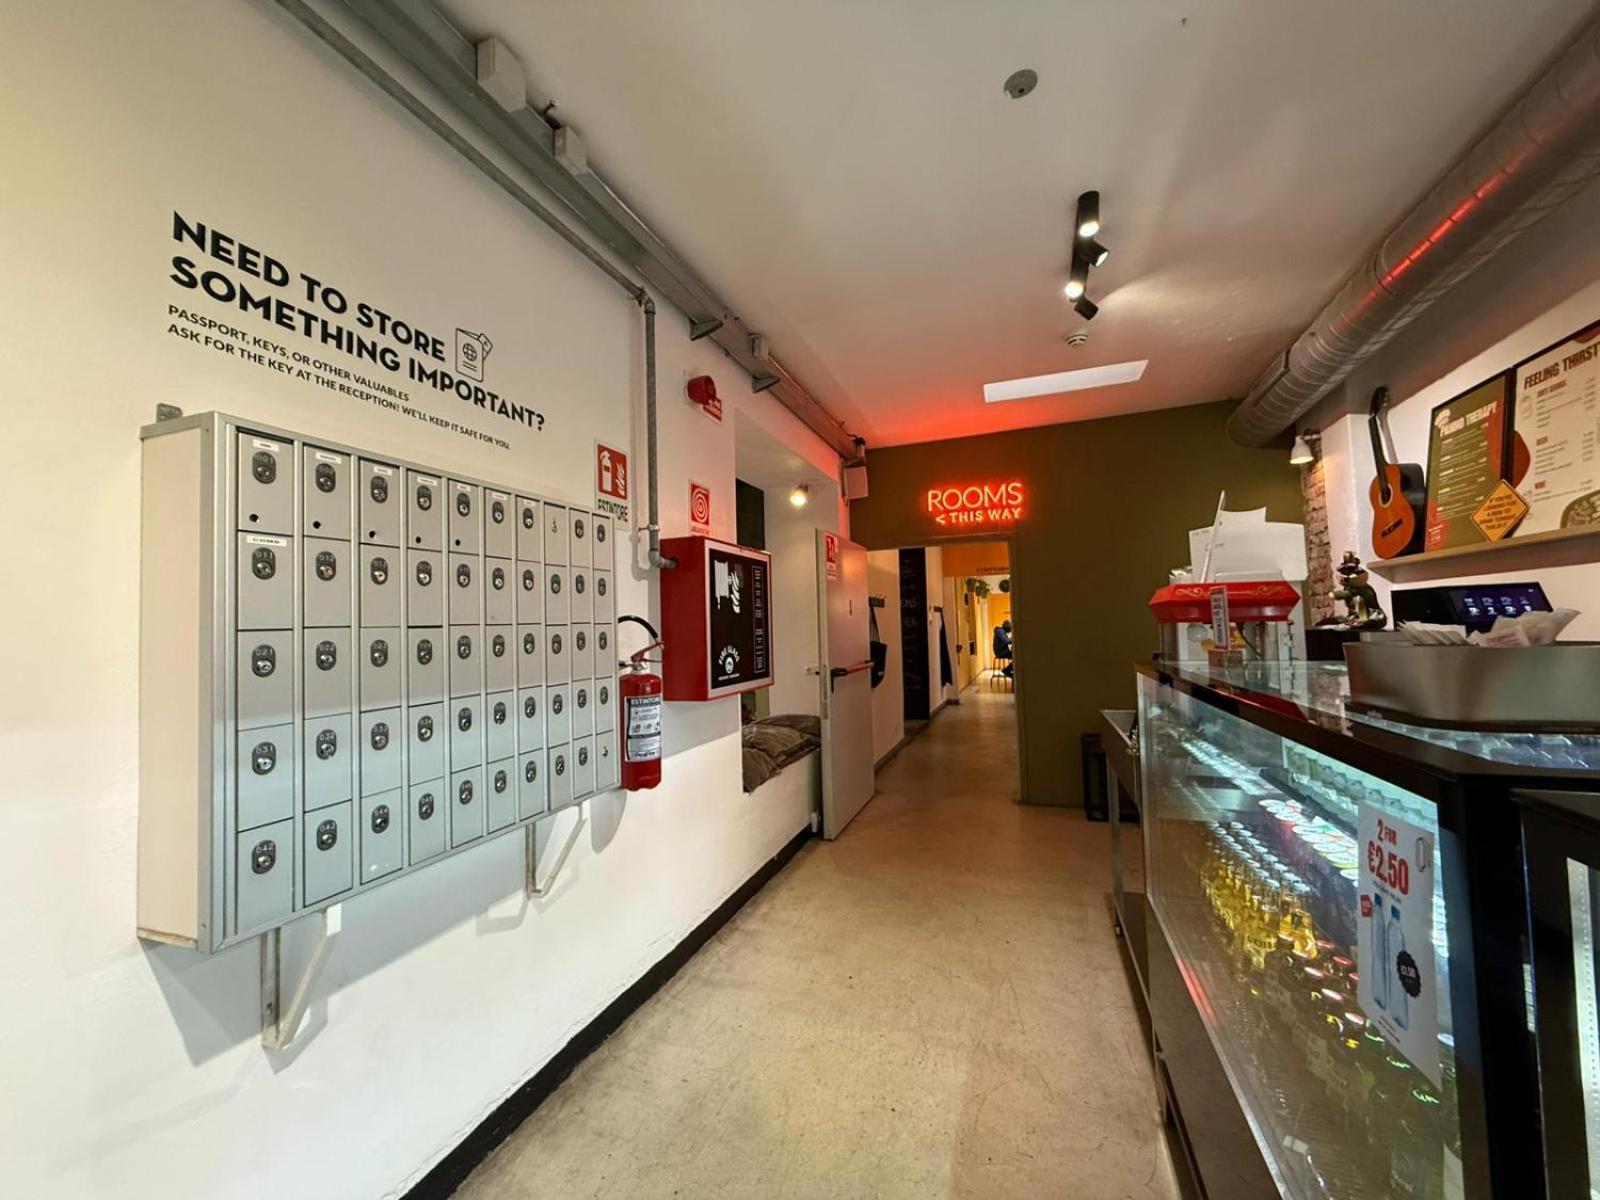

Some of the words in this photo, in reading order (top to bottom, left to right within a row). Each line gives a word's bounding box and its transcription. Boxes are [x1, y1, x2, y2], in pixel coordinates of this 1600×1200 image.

[173, 210, 290, 289] NEED
[300, 272, 347, 315] TO
[356, 302, 446, 362] STORE
[168, 304, 251, 345] PASSPORT,
[253, 336, 290, 360] KEYS,
[291, 351, 311, 366] OR
[312, 359, 352, 382] OTHER
[353, 373, 410, 402] VALUABLES
[169, 256, 401, 373] SOMETHING
[408, 357, 546, 432] IMPORTANT?
[1523, 362, 1560, 390] FEELING
[1561, 341, 1600, 372] THIRST
[167, 323, 201, 344] ASK
[204, 335, 235, 356] FOR
[238, 347, 265, 366] THE
[268, 358, 294, 376] KEY
[296, 369, 312, 382] AT
[314, 374, 337, 391] THE
[338, 383, 400, 413] RECEPTION!
[401, 404, 429, 422] WE'LL
[429, 415, 450, 429] KEEP
[450, 422, 460, 433] IT
[459, 426, 479, 440] SAFE
[479, 432, 494, 445] FOR
[927, 482, 1023, 512] ROOMS
[949, 510, 984, 524] THIS
[987, 507, 1022, 521] WAY
[1377, 818, 1384, 843] 2
[1385, 826, 1397, 846] FOR
[1367, 840, 1410, 896] €2.50
